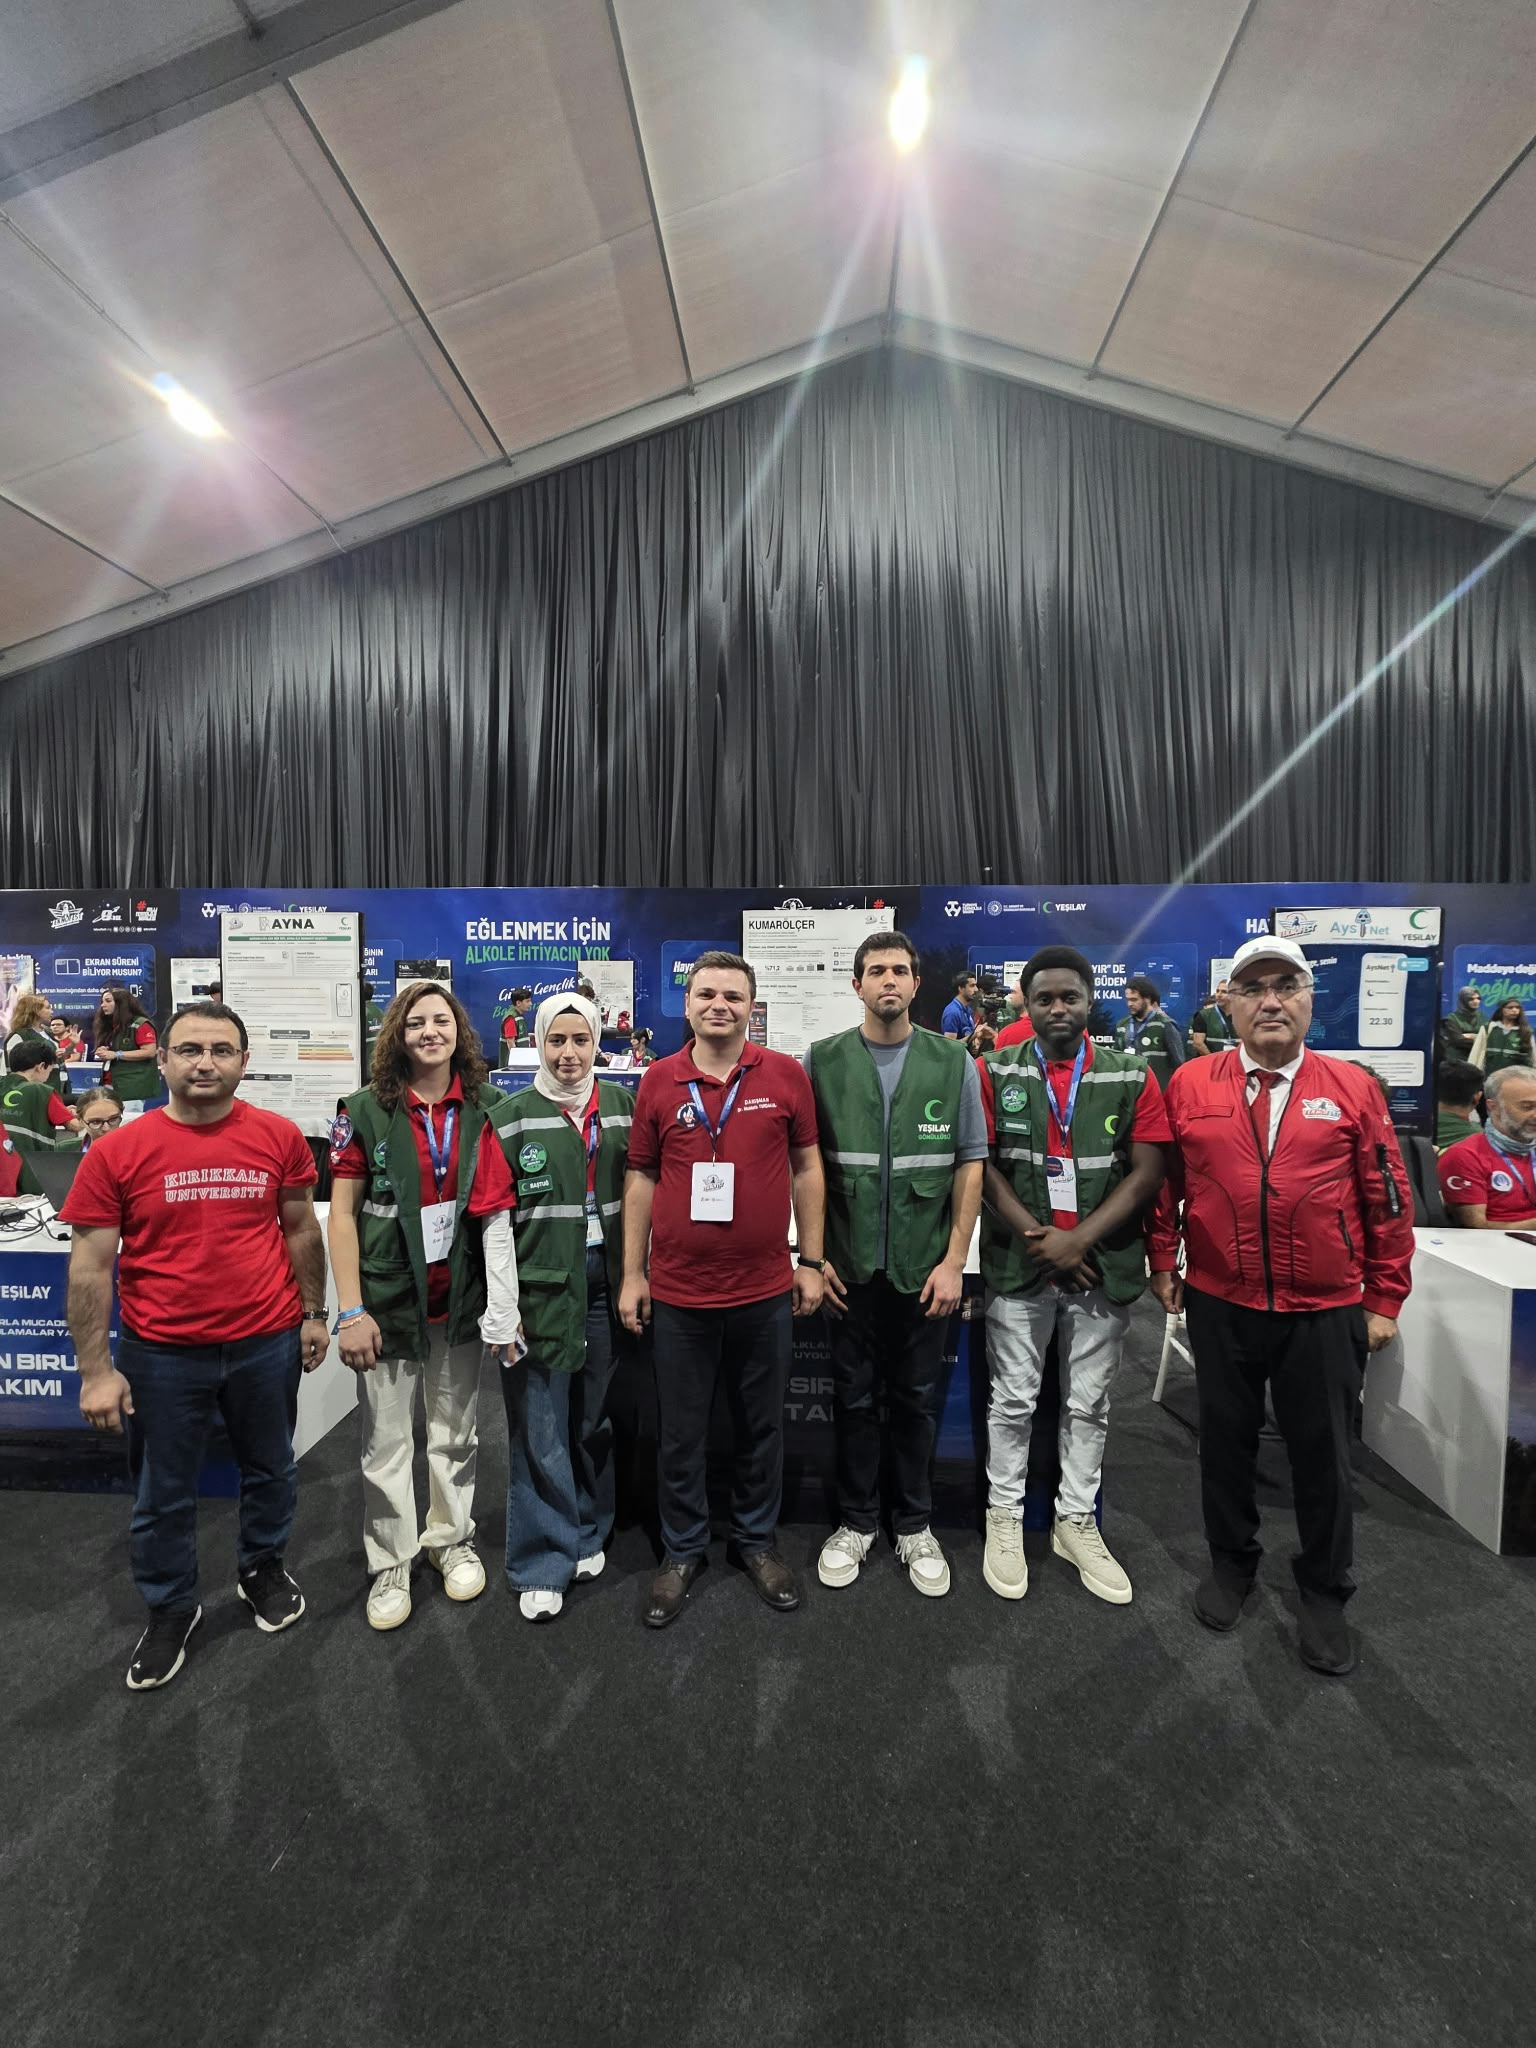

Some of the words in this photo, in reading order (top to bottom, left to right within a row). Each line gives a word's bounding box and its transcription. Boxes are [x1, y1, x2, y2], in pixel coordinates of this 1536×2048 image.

[272, 918, 315, 930] AYNA
[466, 917, 568, 941] EĞLENMEK
[572, 916, 611, 946] İÇİN
[748, 917, 815, 932] KUMARÖLÇER
[1246, 918, 1271, 934] HA
[465, 945, 516, 965] ALKOLE
[518, 941, 582, 962] İHTİYACIN
[585, 945, 611, 961] YOK
[84, 958, 111, 966] EKRAN
[111, 956, 139, 966] SÜRENİ
[82, 967, 111, 976] BİLİYOR
[111, 968, 143, 976] MUSUN?
[1112, 964, 1126, 974] DE
[533, 976, 576, 996] Gençlik
[1102, 989, 1123, 1000] KAL
[1369, 1017, 1393, 1026] 22.30
[163, 1167, 269, 1189] KIRIKKALE
[165, 1186, 266, 1203] UNIVERSITY
[0, 1328, 55, 1337] LAMALAR
[783, 1403, 834, 1422] TA
